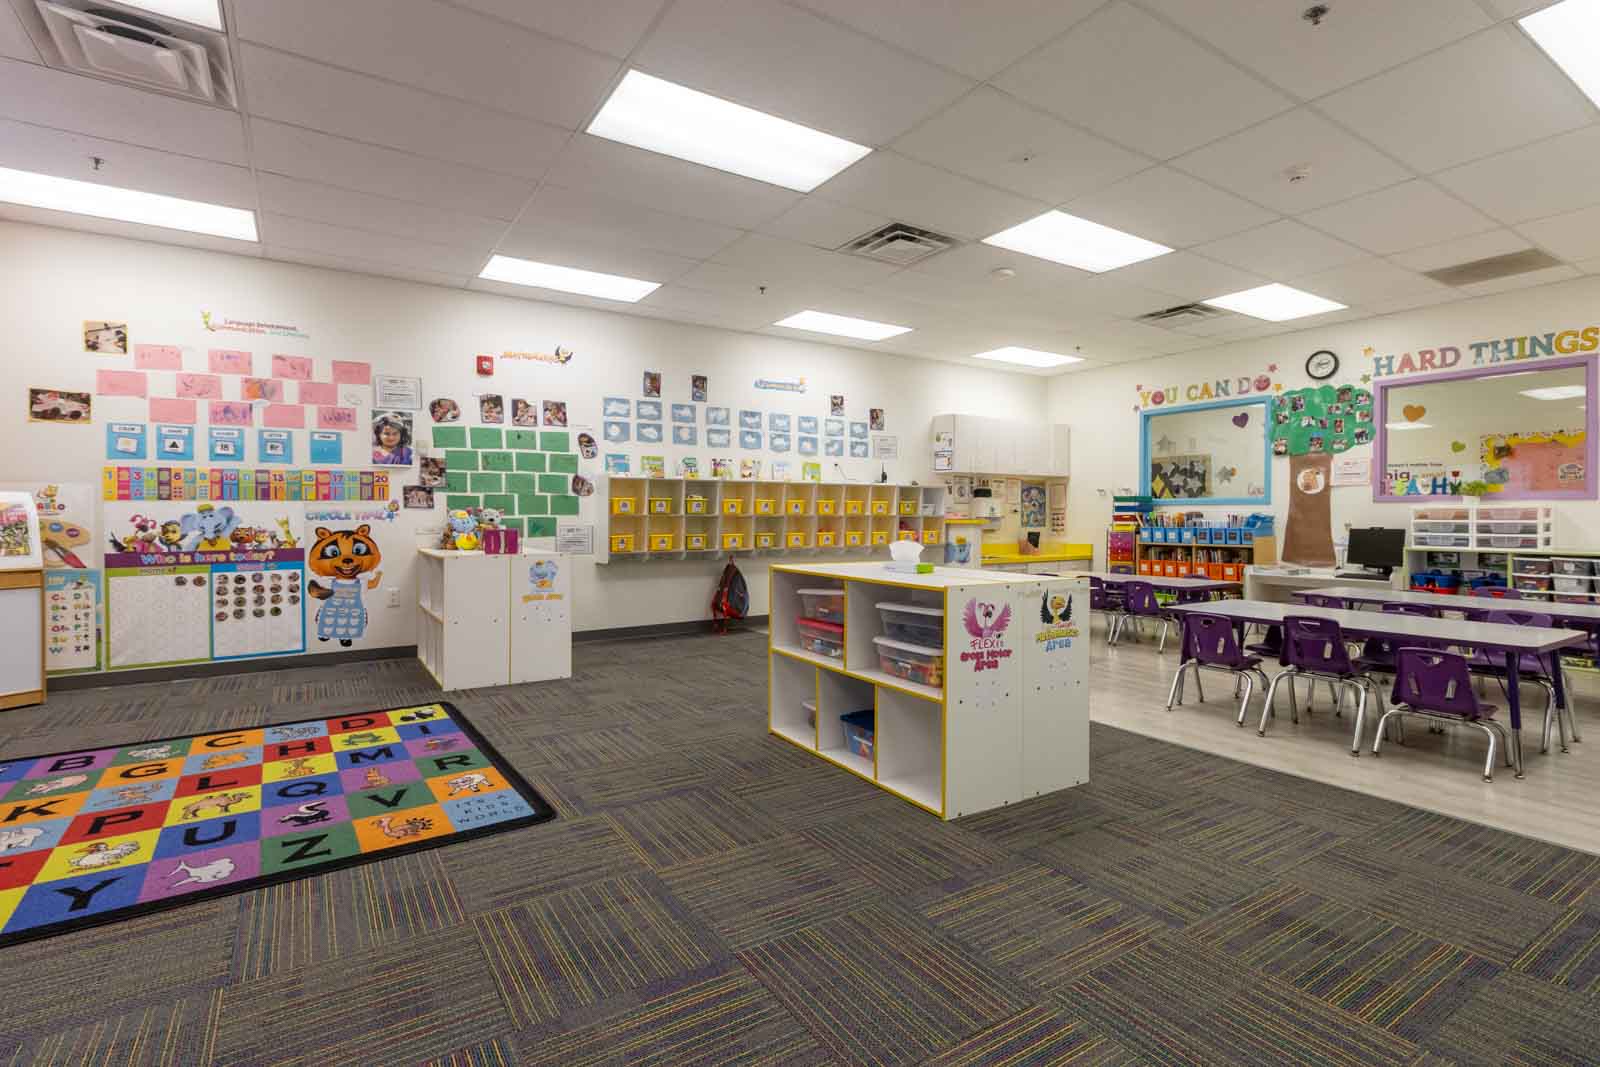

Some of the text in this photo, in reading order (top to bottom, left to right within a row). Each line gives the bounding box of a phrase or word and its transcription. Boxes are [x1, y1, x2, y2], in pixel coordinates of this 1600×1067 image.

[1374, 327, 1599, 377] HARD THINGS
[1139, 375, 1271, 407] YOU CAN DO
[141, 554, 176, 565] Who
[180, 553, 192, 563] is
[341, 716, 377, 731] D
[205, 735, 245, 749] C
[277, 740, 315, 756] H
[48, 755, 96, 772] B
[350, 747, 394, 765] M
[434, 755, 474, 771] R
[120, 761, 169, 780] G
[197, 772, 239, 792] L
[276, 779, 328, 801] Q
[367, 788, 408, 810] V
[1, 798, 68, 823] K
[87, 809, 146, 836] P
[183, 818, 238, 847] U
[281, 834, 333, 865] Z
[56, 878, 122, 912] Y
